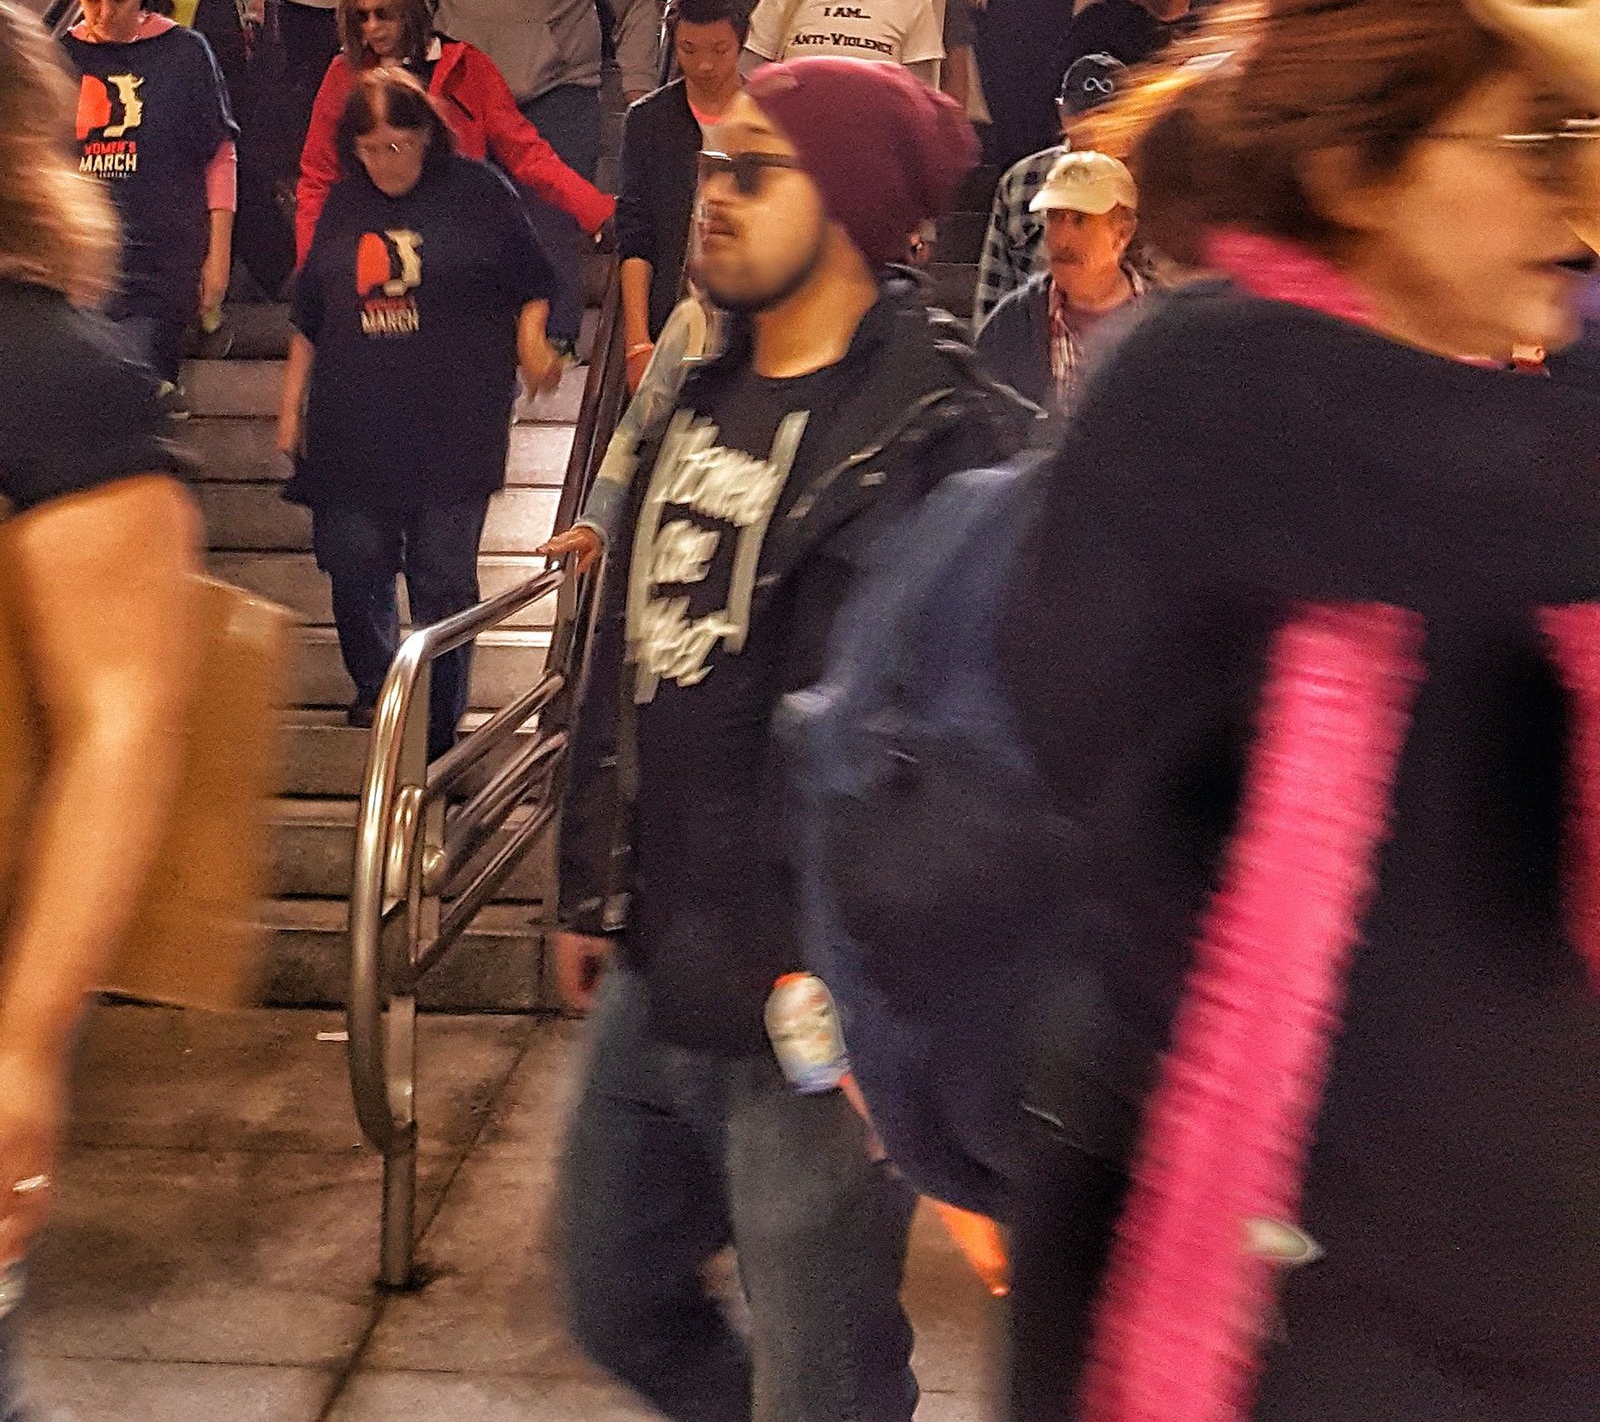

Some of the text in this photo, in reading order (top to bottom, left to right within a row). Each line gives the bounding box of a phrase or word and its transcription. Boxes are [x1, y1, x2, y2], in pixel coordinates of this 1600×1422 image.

[824, 8, 831, 17] I
[84, 141, 137, 155] WOMEN'S
[79, 153, 138, 172] MARCH
